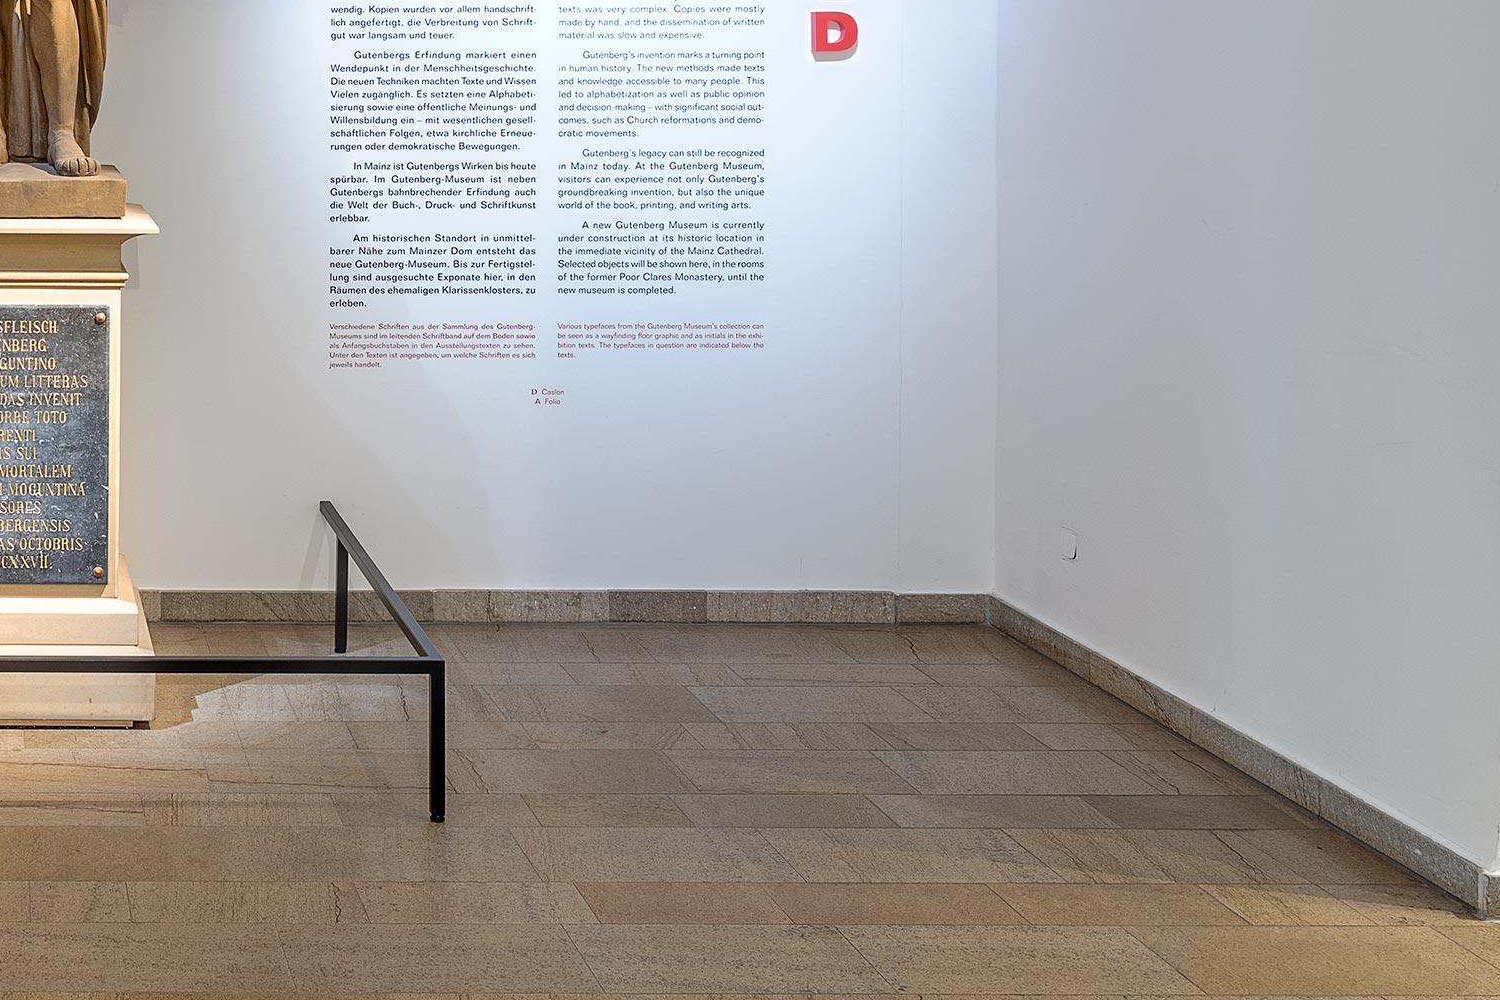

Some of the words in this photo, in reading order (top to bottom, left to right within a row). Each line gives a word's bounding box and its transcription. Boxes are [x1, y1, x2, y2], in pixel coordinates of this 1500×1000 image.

[353, 50, 411, 61] Gutenbergs
[414, 50, 462, 61] Erfindung
[465, 50, 506, 59] markiert
[510, 50, 537, 59] einen
[330, 64, 389, 75] Wendepunkt
[392, 64, 401, 73] in
[404, 64, 421, 73] der
[423, 64, 537, 75] Menschheitsgeschichte.
[330, 77, 347, 86] Die
[347, 78, 375, 86] neuen
[376, 77, 420, 86] Techniken
[421, 77, 460, 86] machten
[460, 77, 485, 86] Texte
[485, 77, 503, 86] und
[503, 77, 537, 86] Wissen
[330, 144, 363, 153] rungen
[364, 142, 387, 151] oder
[387, 142, 456, 151] demokratische
[458, 142, 521, 153] Bewegungen.
[581, 148, 637, 159] Gutenberg's
[638, 148, 668, 159] legacy
[686, 148, 703, 157] still
[703, 148, 716, 157] be
[717, 148, 765, 159] recognized
[353, 162, 363, 171] In
[363, 162, 392, 171] Mainz
[392, 162, 405, 171] ist
[406, 162, 460, 173] Gutenbergs
[460, 162, 494, 171] Wirken
[495, 162, 509, 171] bis
[510, 162, 537, 171] heute
[558, 162, 567, 171] in
[570, 162, 599, 171] Mainz
[602, 162, 631, 172] today.
[634, 162, 646, 171] At
[649, 162, 666, 171] the
[668, 162, 719, 172] Gutenberg
[722, 162, 765, 172] Museum,
[329, 188, 384, 198] Gutenbergs
[387, 188, 463, 197] bahnbrechender
[466, 188, 511, 198] Erfindung
[514, 188, 537, 197] auch
[329, 200, 344, 210] die
[347, 200, 369, 210] Welt
[372, 200, 389, 210] der
[391, 200, 421, 211] Buch-,
[425, 200, 456, 210] Druck-
[459, 200, 477, 210] und
[480, 200, 536, 210] Schriftkunst
[557, 201, 583, 210] world
[584, 201, 595, 210] of
[596, 201, 612, 210] the
[613, 201, 638, 211] book,
[640, 201, 677, 212] printing,
[679, 201, 696, 210] and
[697, 201, 729, 212] writing
[730, 201, 752, 210] arts.
[581, 220, 590, 230] A
[592, 222, 613, 230] new
[614, 220, 665, 231] Gutenberg
[668, 220, 708, 230] Museum
[711, 220, 720, 230] is
[722, 220, 765, 231] currently
[352, 234, 369, 243] Am
[372, 234, 431, 243] historischen
[434, 234, 477, 243] Standort
[480, 234, 490, 243] in
[493, 234, 536, 243] unmittel-
[329, 273, 350, 283] lung
[352, 273, 373, 282] sind
[374, 273, 435, 283] ausgesuchte
[437, 273, 481, 283] Exponate
[483, 273, 504, 283] hier,
[506, 273, 516, 282] in
[518, 273, 536, 282] den
[617, 285, 626, 294] is
[627, 285, 677, 296] completed.
[329, 299, 367, 309] erleben.
[24, 374, 88, 389] LITTERAS
[35, 410, 68, 424] TOTO
[16, 446, 37, 460] SUI
[8, 482, 86, 496] MOGUNTINA
[19, 537, 83, 551] OCTOBRIS
